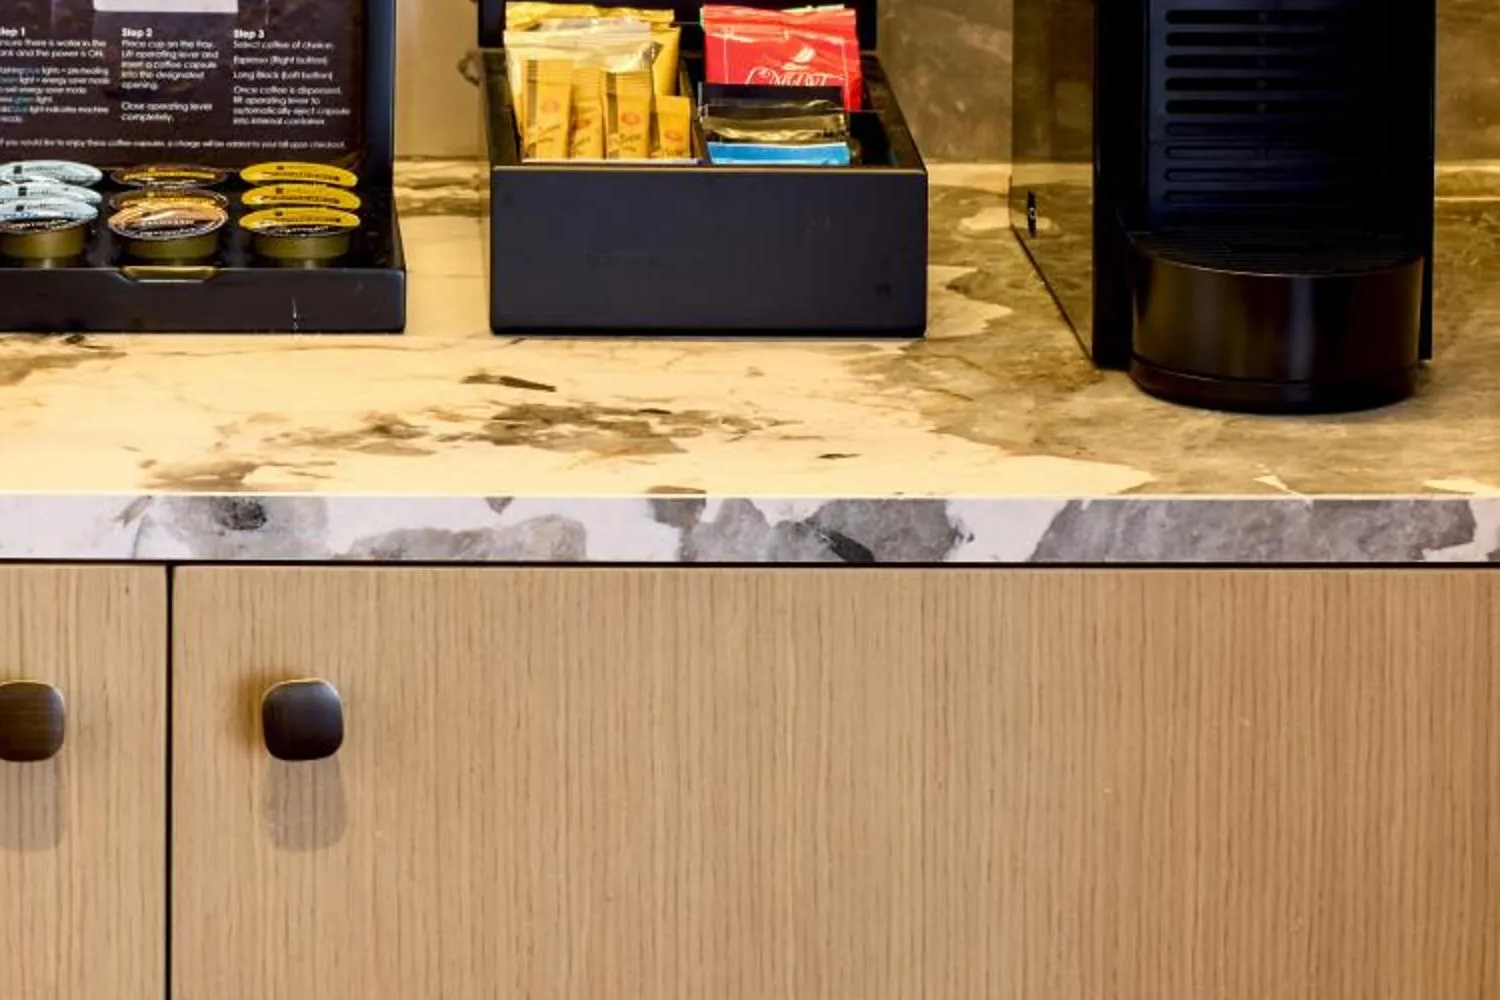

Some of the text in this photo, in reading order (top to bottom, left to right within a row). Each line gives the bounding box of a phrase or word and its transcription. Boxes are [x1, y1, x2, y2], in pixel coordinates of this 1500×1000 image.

[21, 27, 25, 36] 1
[122, 27, 153, 39] Step 2
[233, 28, 265, 41] Step 3
[148, 41, 164, 50] cup
[180, 40, 194, 49] the
[262, 41, 290, 49] coffee
[291, 40, 301, 49] of
[136, 50, 177, 60] operating
[178, 50, 199, 58] lever
[201, 50, 219, 59] and
[154, 60, 182, 69] coffee
[184, 61, 217, 71] capsule
[140, 71, 154, 79] the
[155, 71, 205, 81] designated
[233, 85, 257, 95] Once
[260, 85, 288, 94] coffee
[245, 96, 287, 106] operating
[121, 101, 213, 113] Close operating lever
[233, 107, 291, 117] automatically
